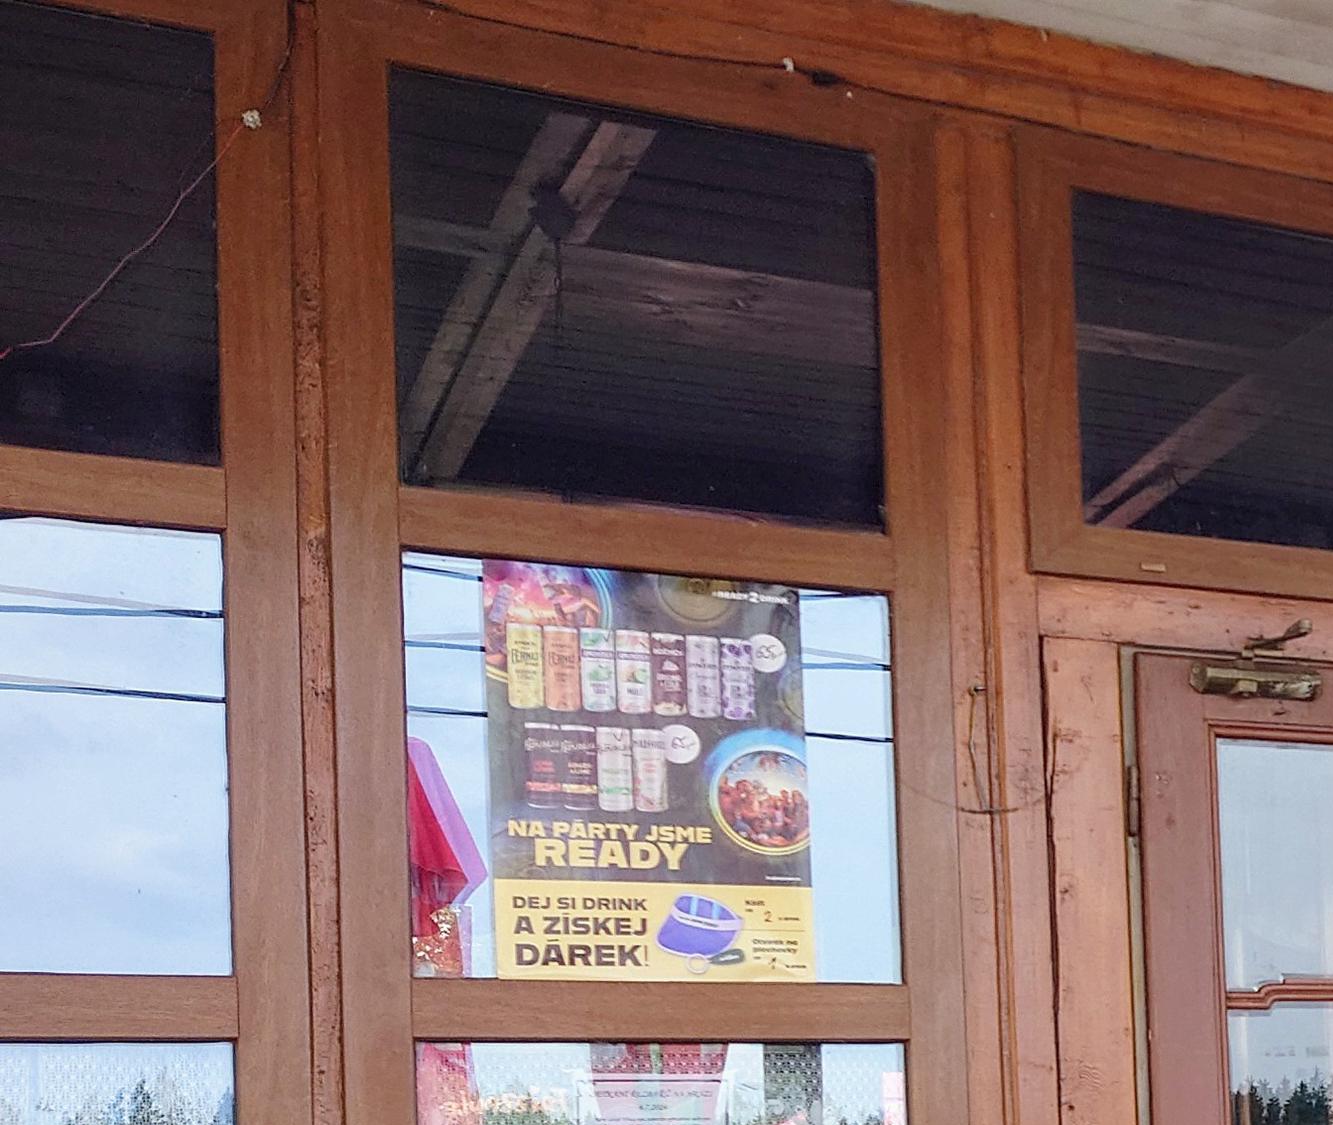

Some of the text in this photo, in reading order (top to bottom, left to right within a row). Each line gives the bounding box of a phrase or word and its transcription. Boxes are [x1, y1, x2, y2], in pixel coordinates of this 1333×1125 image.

[507, 818, 713, 844] NA PÁRTY JSME
[534, 838, 690, 871] READY
[512, 896, 647, 912] DEJ SI DRINK
[513, 912, 647, 937] A ZÍSKEJ
